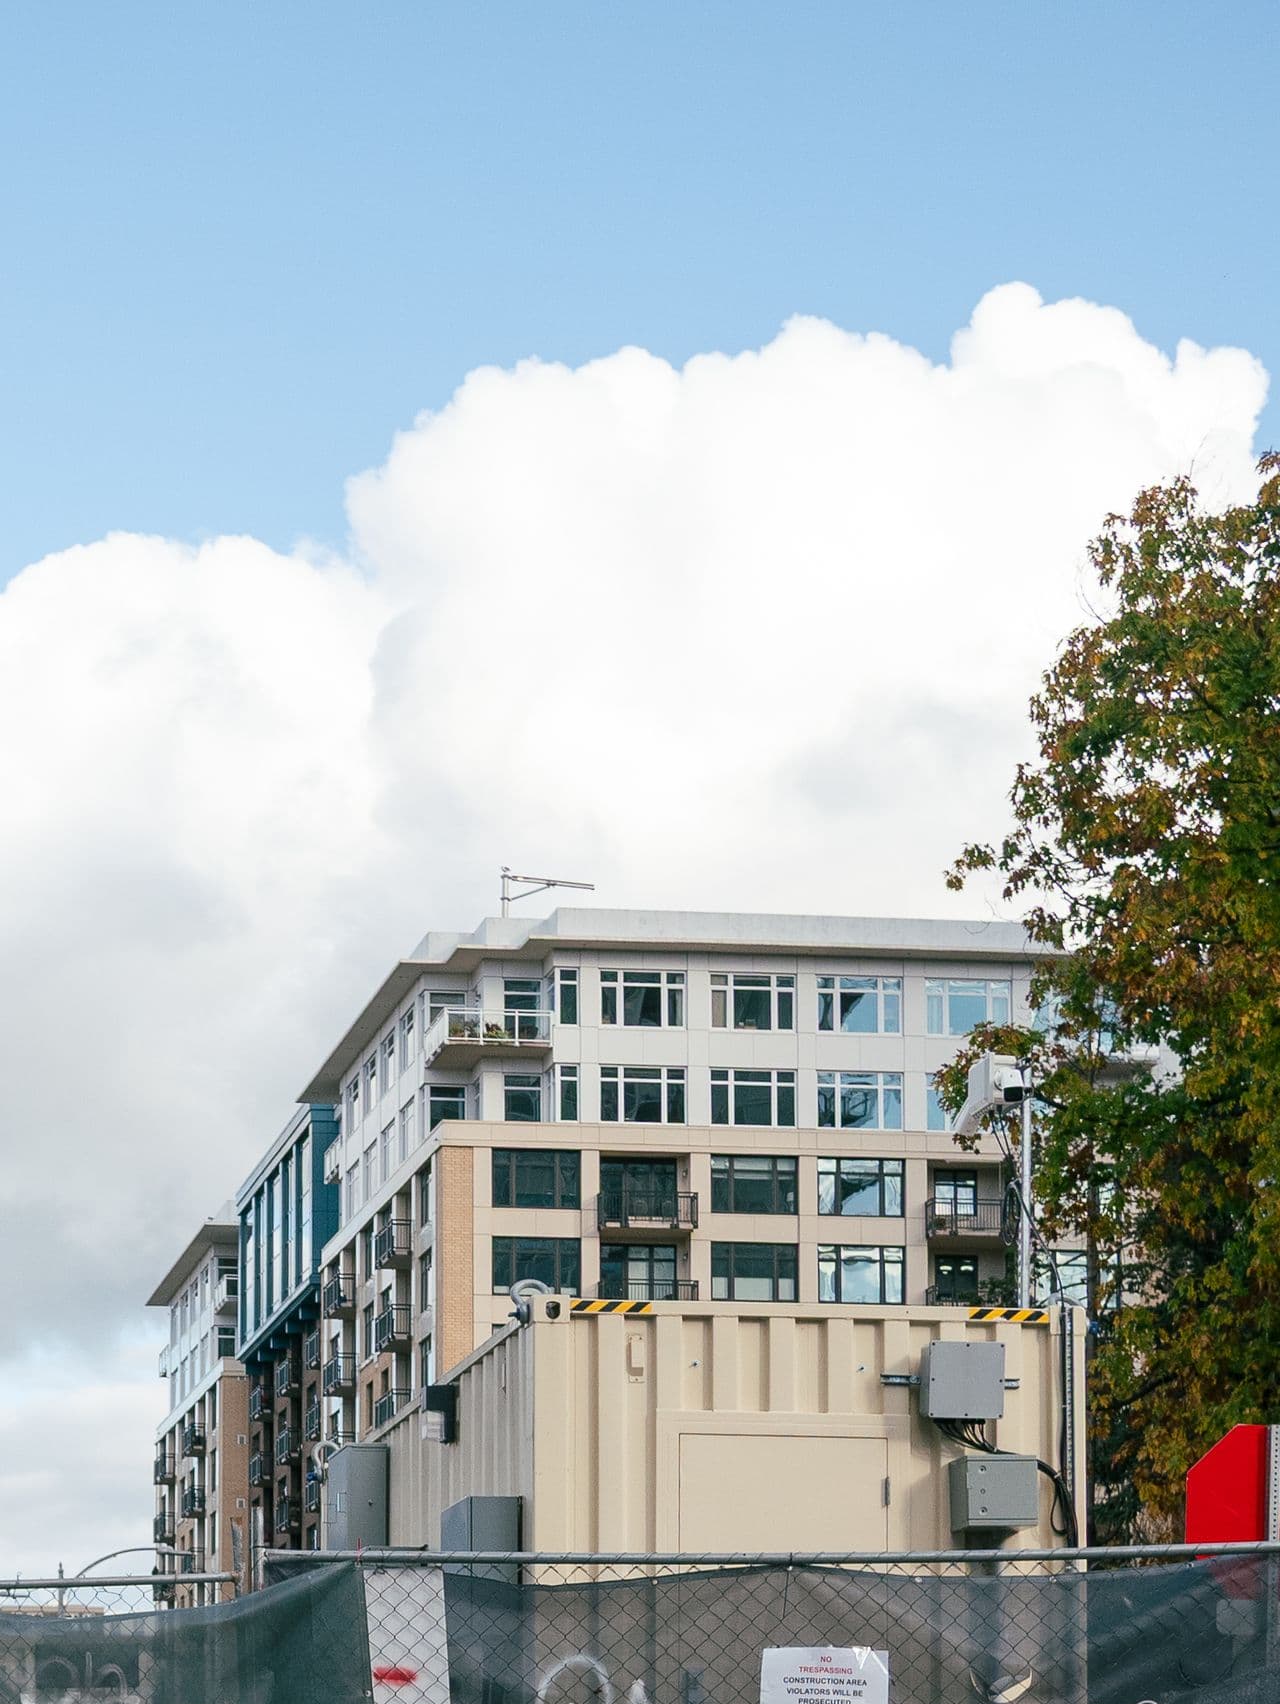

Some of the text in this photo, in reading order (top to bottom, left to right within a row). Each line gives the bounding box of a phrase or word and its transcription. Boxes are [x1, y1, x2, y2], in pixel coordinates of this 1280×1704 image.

[799, 1666, 853, 1675] TRESPASSING
[783, 1676, 845, 1685] CONSTRUCTION
[787, 1687, 863, 1698] VIOLATORS WILL BE
